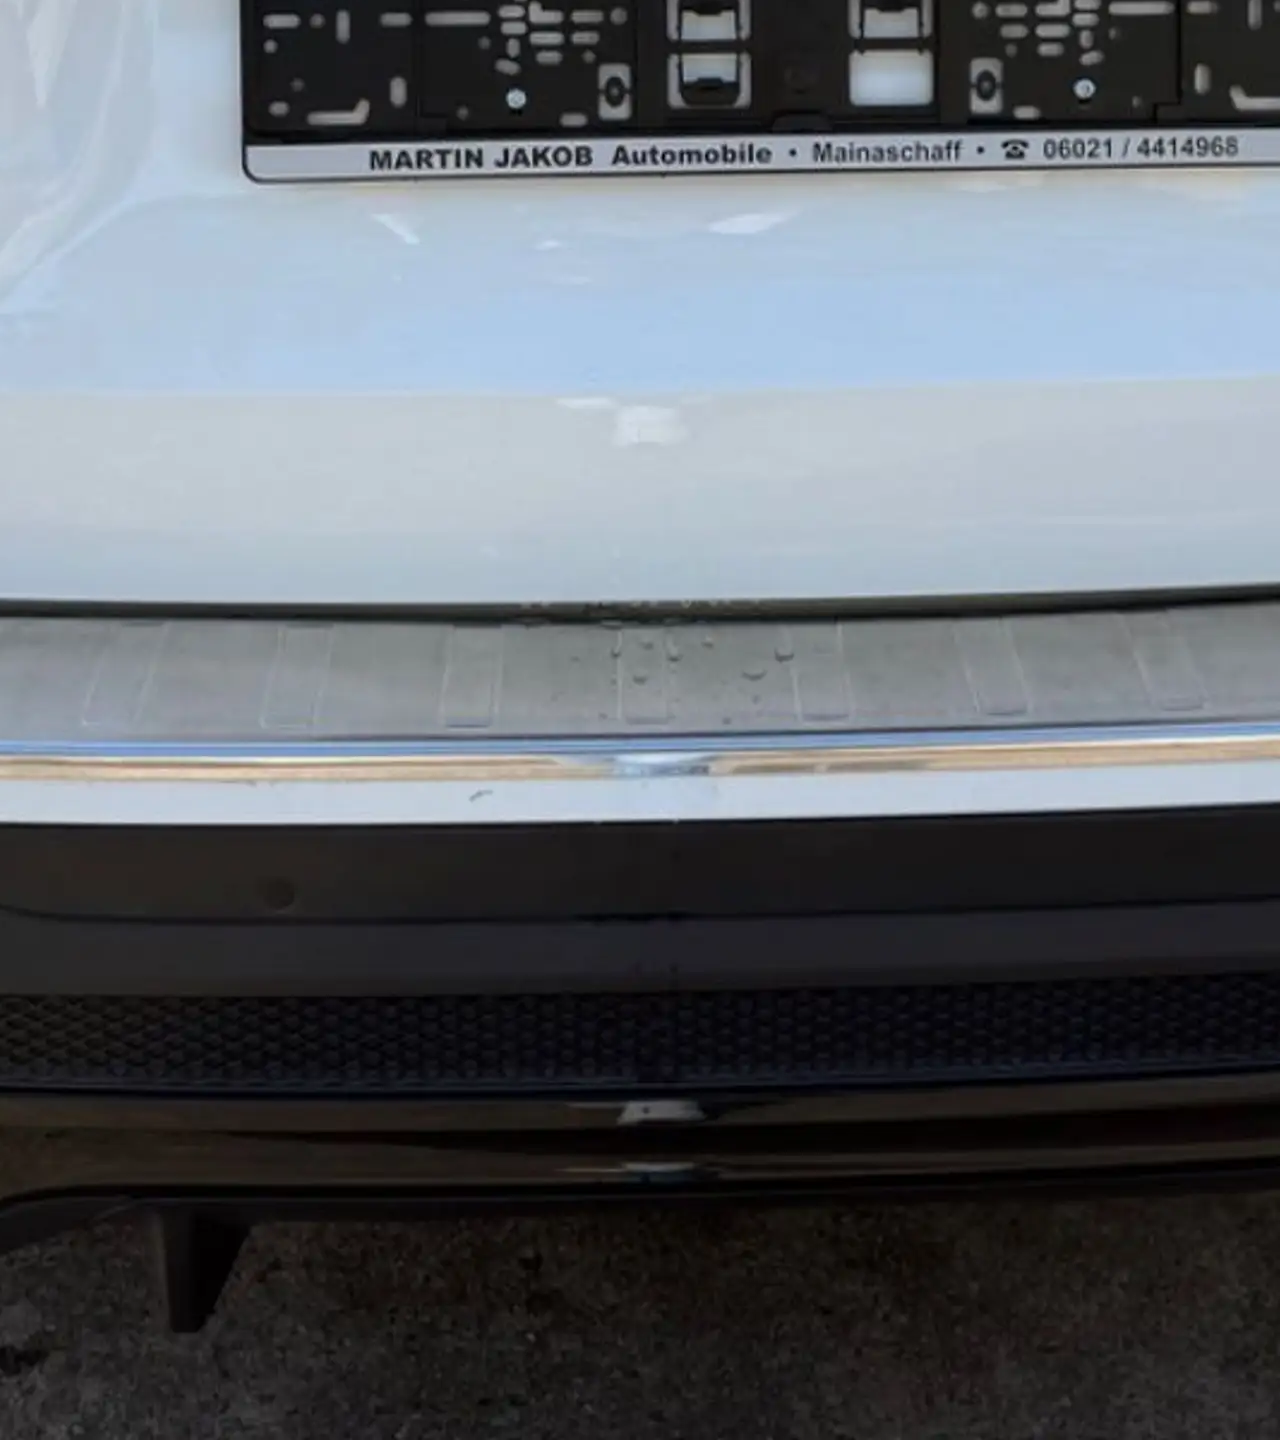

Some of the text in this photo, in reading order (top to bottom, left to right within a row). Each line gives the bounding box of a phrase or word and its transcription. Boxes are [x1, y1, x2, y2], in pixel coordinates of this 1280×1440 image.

[369, 147, 484, 171] MARTIN
[493, 145, 595, 169] JAKOB
[611, 142, 773, 166] Automobile
[811, 137, 963, 163] Mainaschaff
[1042, 137, 1115, 160] 06021
[1136, 135, 1240, 159] 4414968
